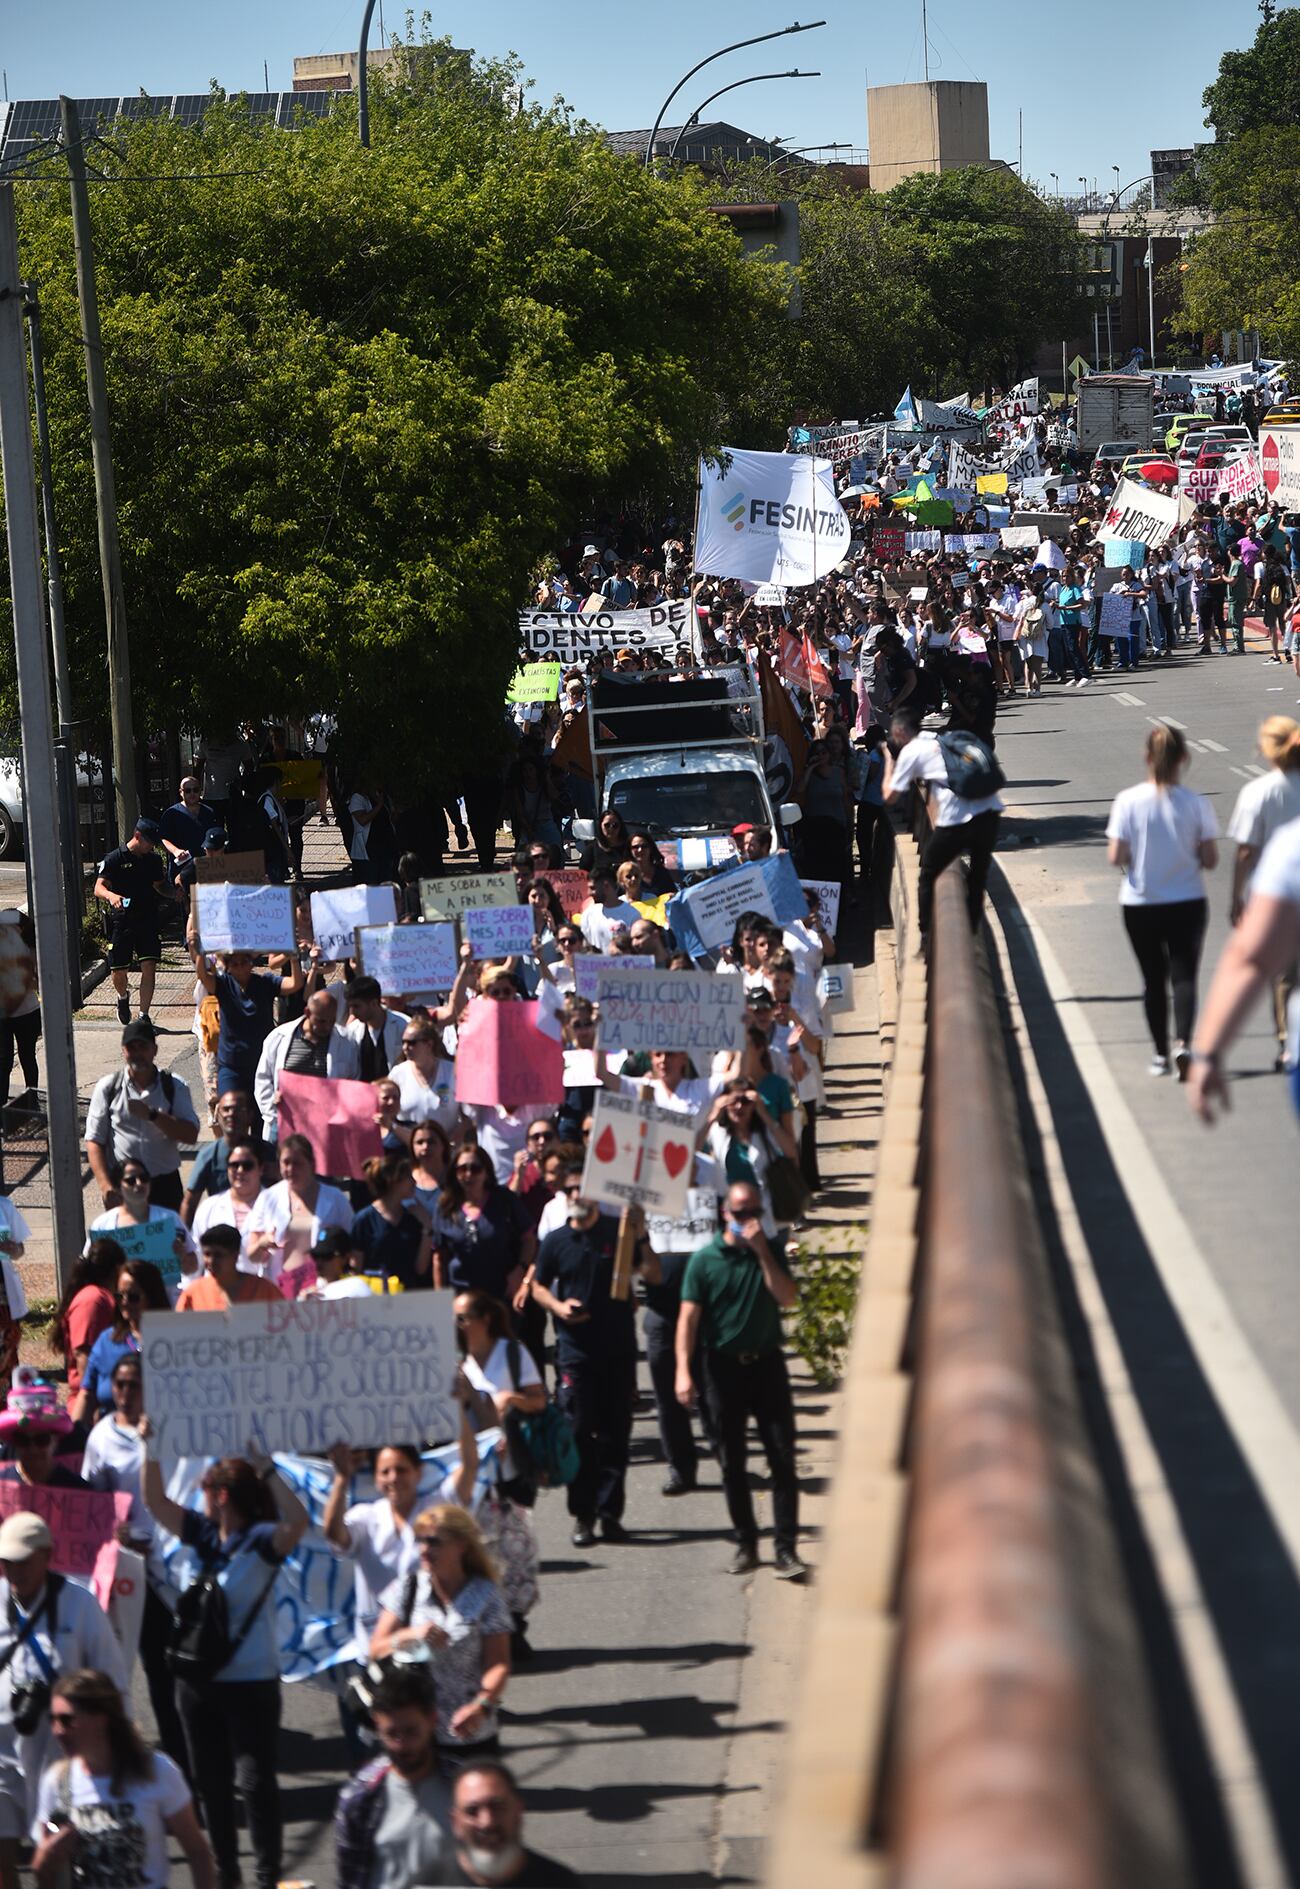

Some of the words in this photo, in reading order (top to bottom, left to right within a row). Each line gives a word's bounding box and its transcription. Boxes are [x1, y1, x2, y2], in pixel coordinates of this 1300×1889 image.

[1189, 460, 1246, 487] GUARDIA
[750, 499, 845, 537] FESINTRAS
[650, 601, 687, 628] DE
[667, 621, 686, 641] Y
[427, 883, 444, 895] ME
[450, 878, 481, 892] SOBRA
[486, 876, 505, 888] MES
[446, 898, 456, 909] A
[460, 895, 477, 907] FIN
[483, 893, 496, 904] DE
[467, 911, 489, 925] ME
[493, 909, 531, 925] SOBRA
[470, 927, 494, 940] MES
[495, 926, 506, 938] A
[510, 924, 530, 937] FIN
[708, 981, 739, 1005] DEL
[650, 1002, 705, 1025] MOVIL
[601, 1021, 622, 1044] LA
[287, 1358, 335, 1401] POR
